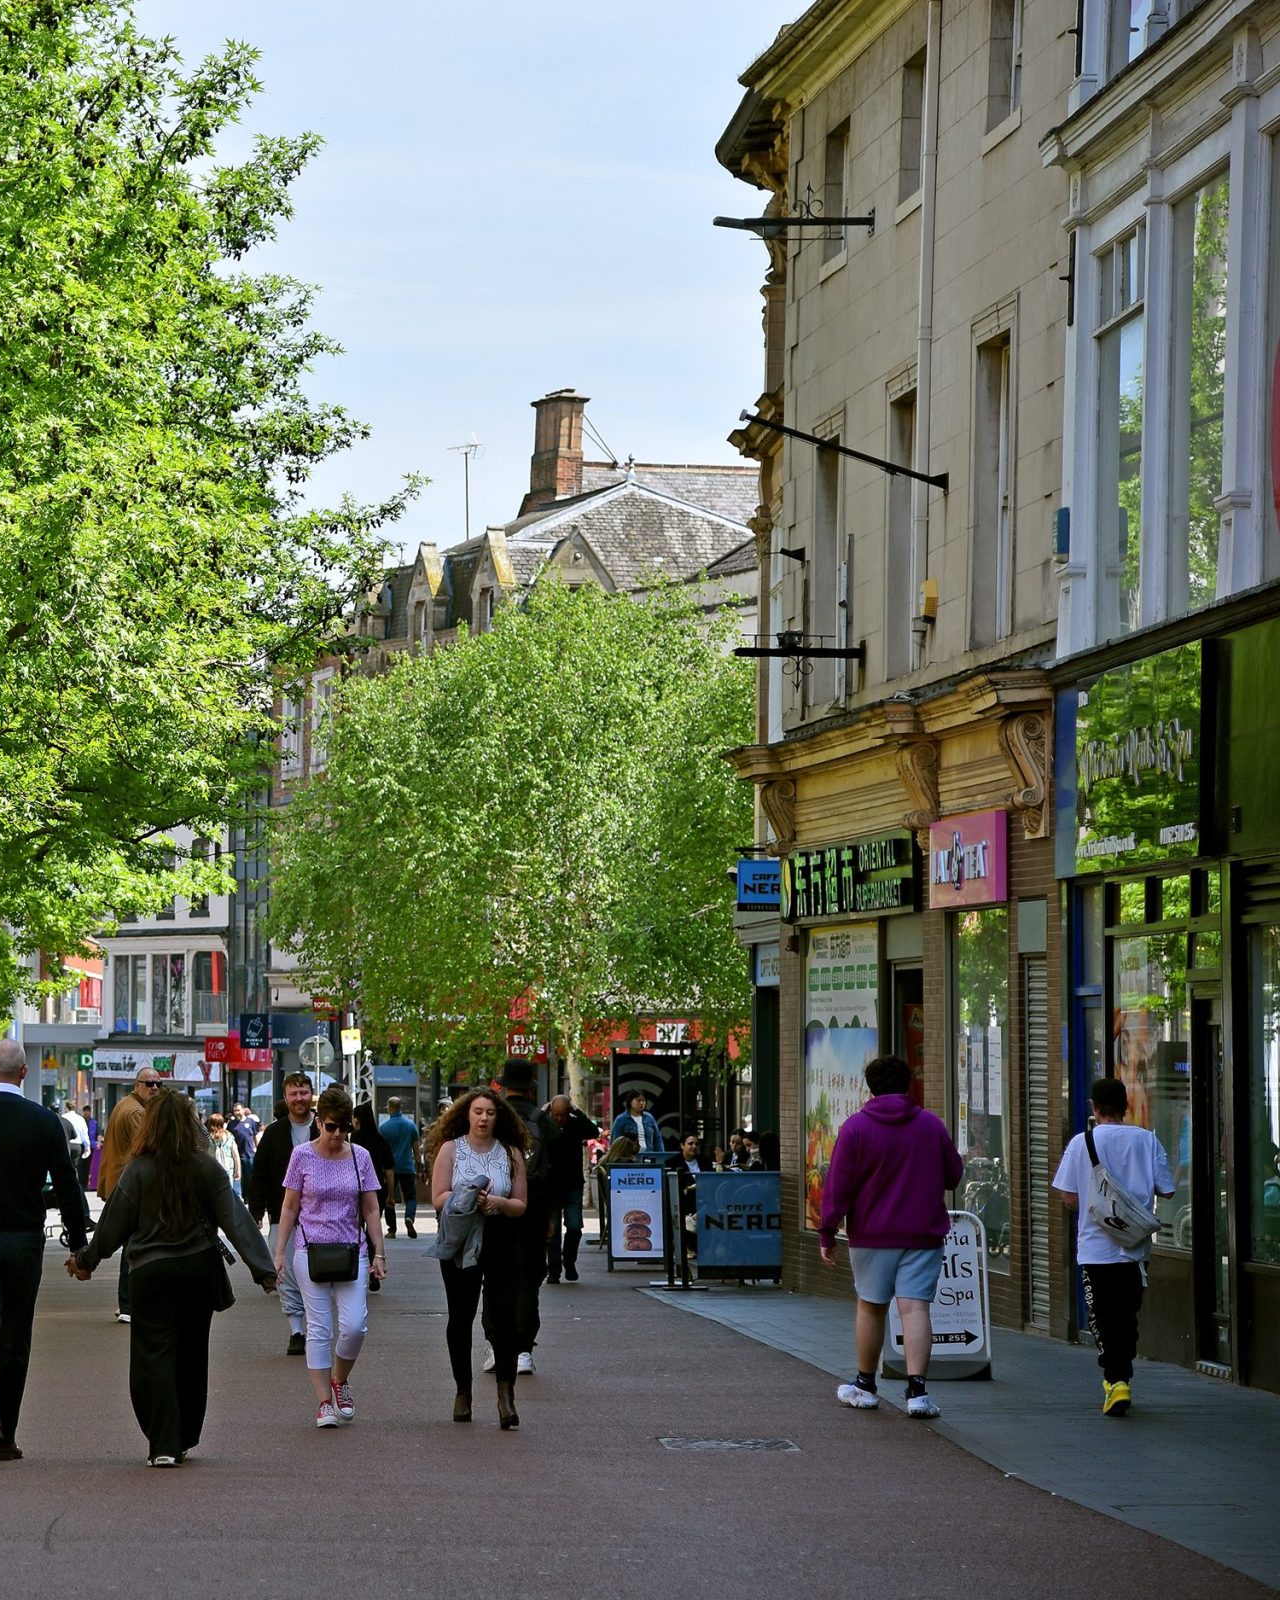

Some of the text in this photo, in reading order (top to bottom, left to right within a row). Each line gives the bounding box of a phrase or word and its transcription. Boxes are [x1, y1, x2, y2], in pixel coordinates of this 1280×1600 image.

[858, 840, 896, 872] ORIENTAL
[752, 873, 780, 881] CAFF
[795, 846, 854, 917] 东方超市
[743, 883, 780, 895] NER
[618, 1177, 655, 1186] NERO
[705, 1213, 781, 1231] NERO
[941, 1254, 973, 1279] ils
[938, 1287, 975, 1306] Spa
